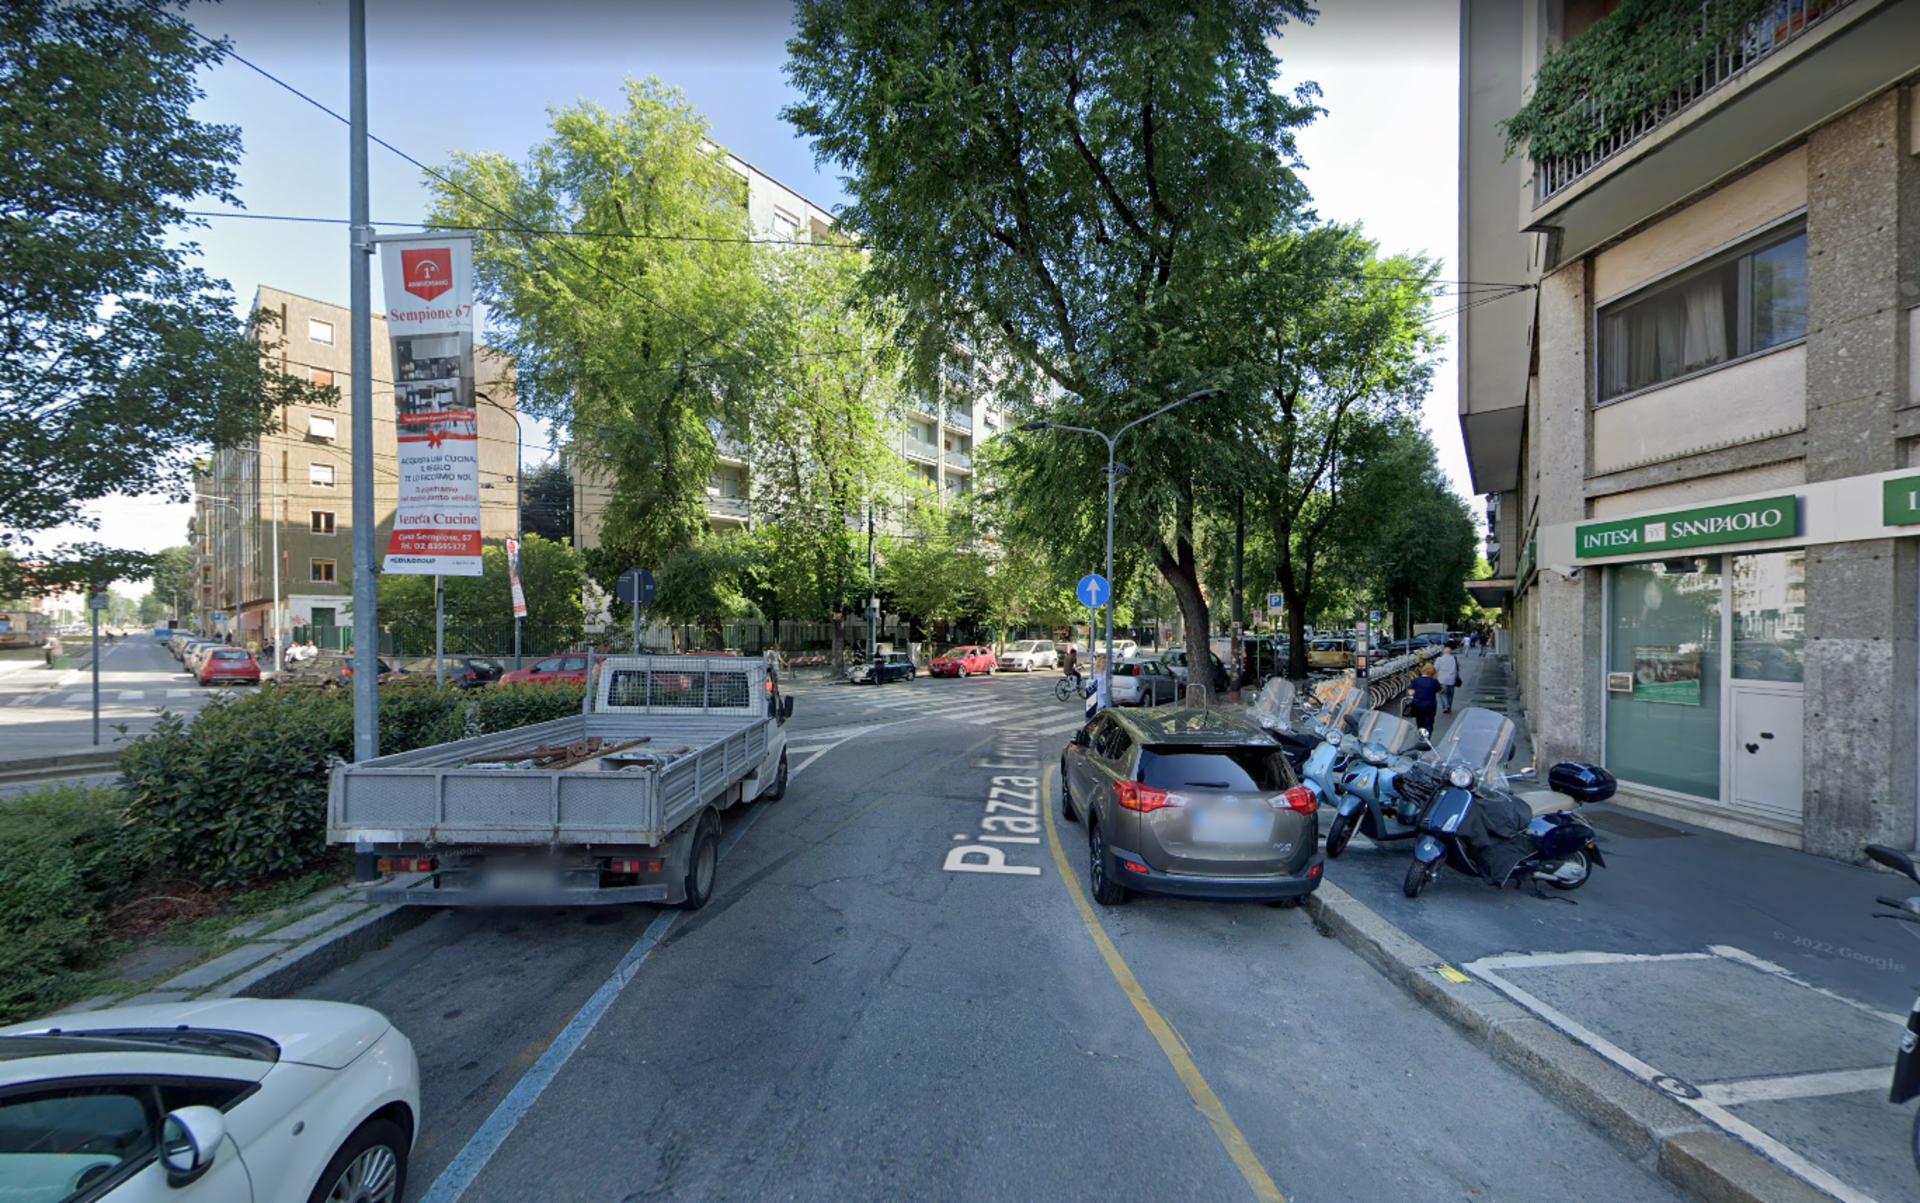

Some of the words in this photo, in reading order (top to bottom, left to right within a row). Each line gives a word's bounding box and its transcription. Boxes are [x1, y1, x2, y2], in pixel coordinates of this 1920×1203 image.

[390, 305, 453, 324] Sempione
[455, 304, 473, 318] 67
[433, 512, 477, 525] Cucine
[1583, 528, 1639, 549] INTESA
[1671, 508, 1782, 539] SANPAOLO
